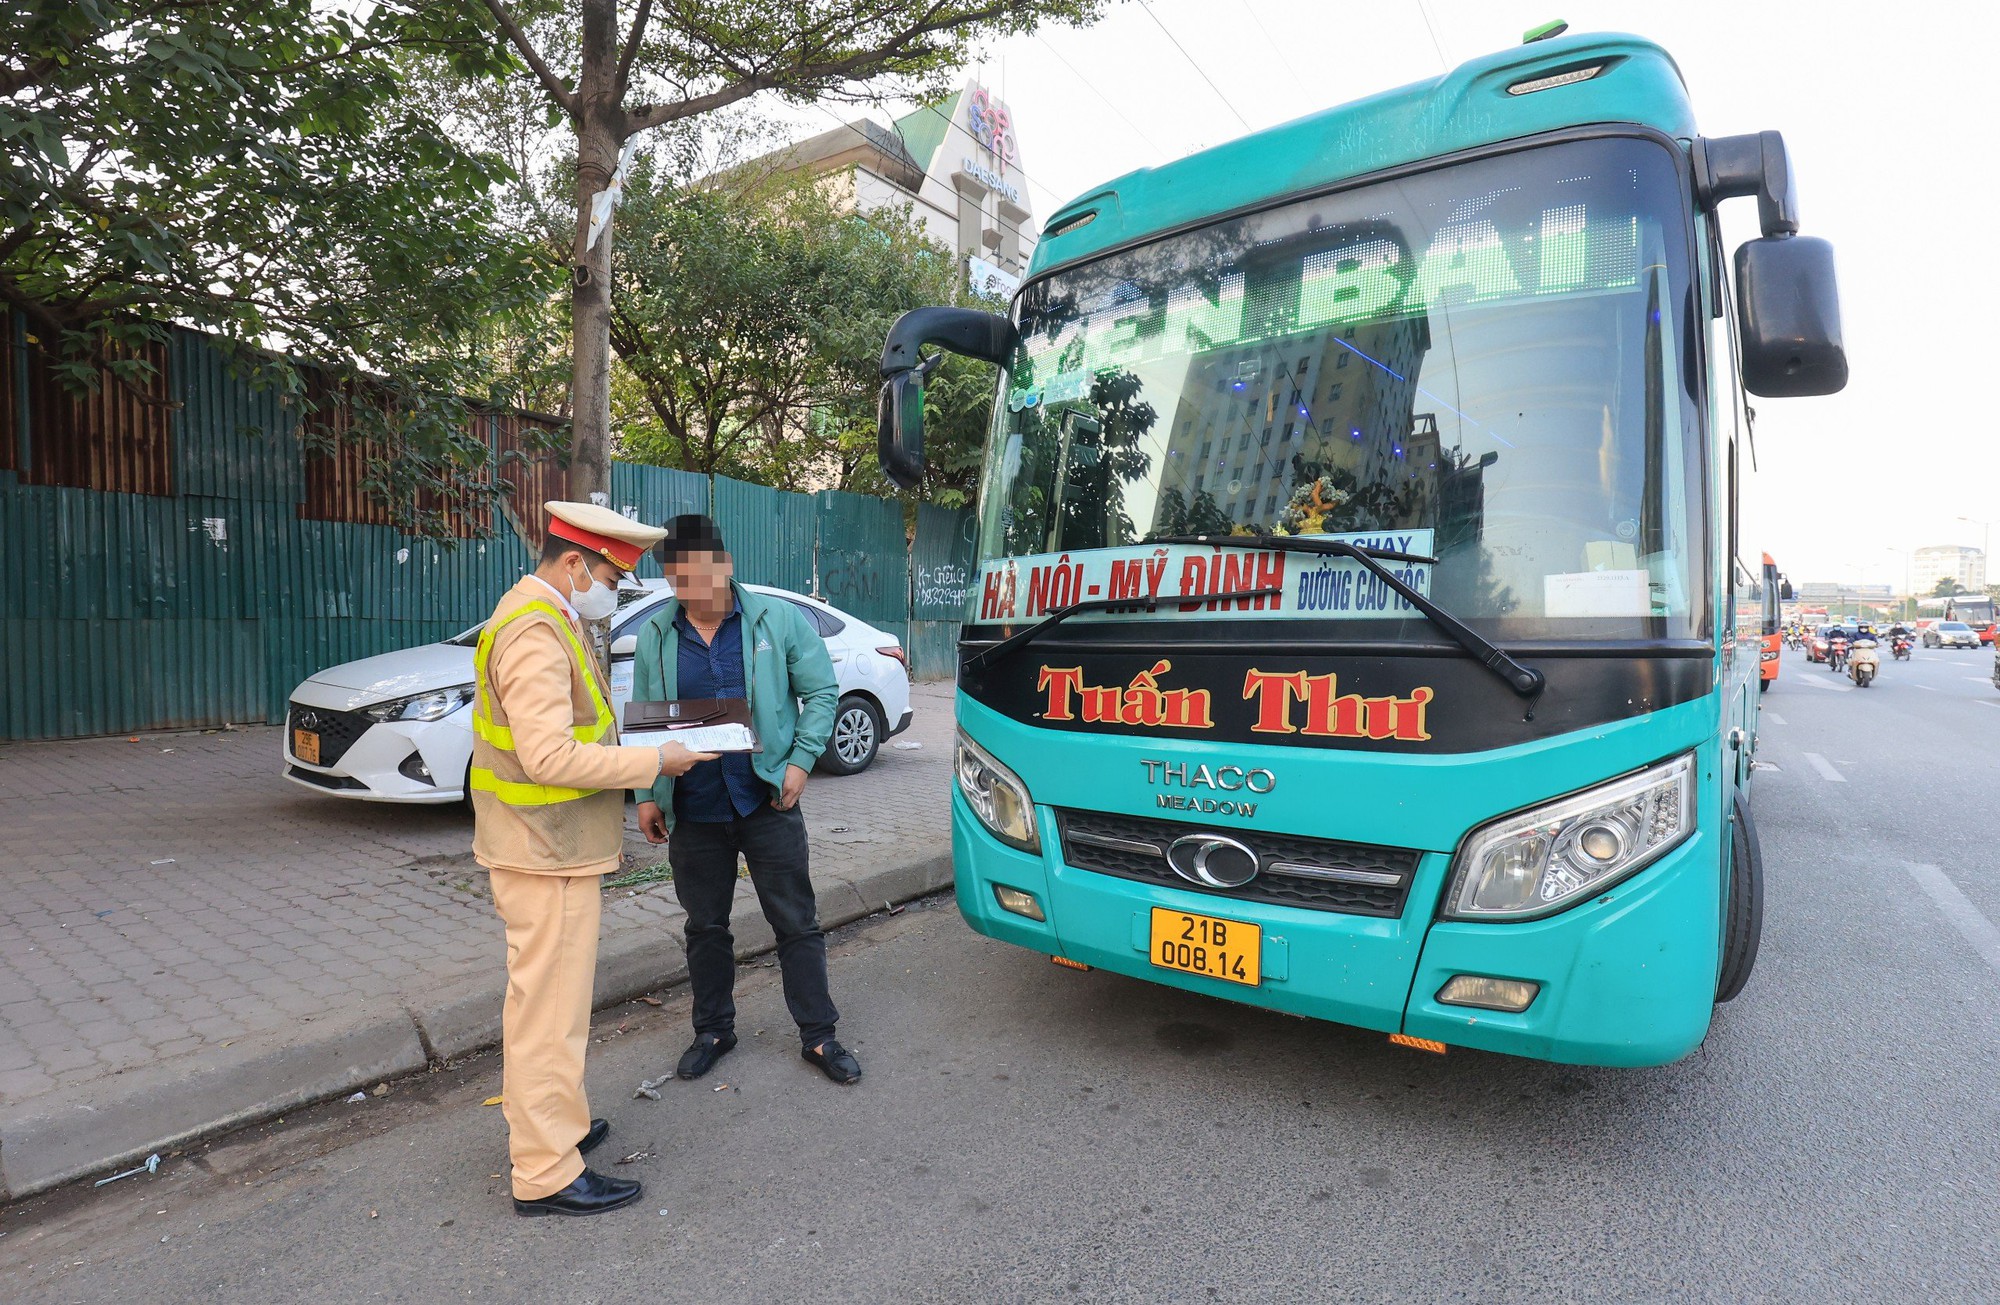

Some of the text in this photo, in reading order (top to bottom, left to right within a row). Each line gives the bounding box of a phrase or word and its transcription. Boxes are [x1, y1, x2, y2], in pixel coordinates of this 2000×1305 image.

[963, 156, 1019, 203] DAESANG
[980, 560, 1016, 620] HÀ
[1106, 548, 1169, 614] MỸ
[1178, 546, 1286, 612] ĐÌNH
[1297, 562, 1352, 611] ĐƯỜNG
[1037, 659, 1433, 741] Tuấn Thư
[1140, 758, 1277, 794] THACO
[1156, 793, 1259, 818] MEADOW
[1181, 916, 1227, 947] 21B
[1162, 940, 1246, 980] 008.14
